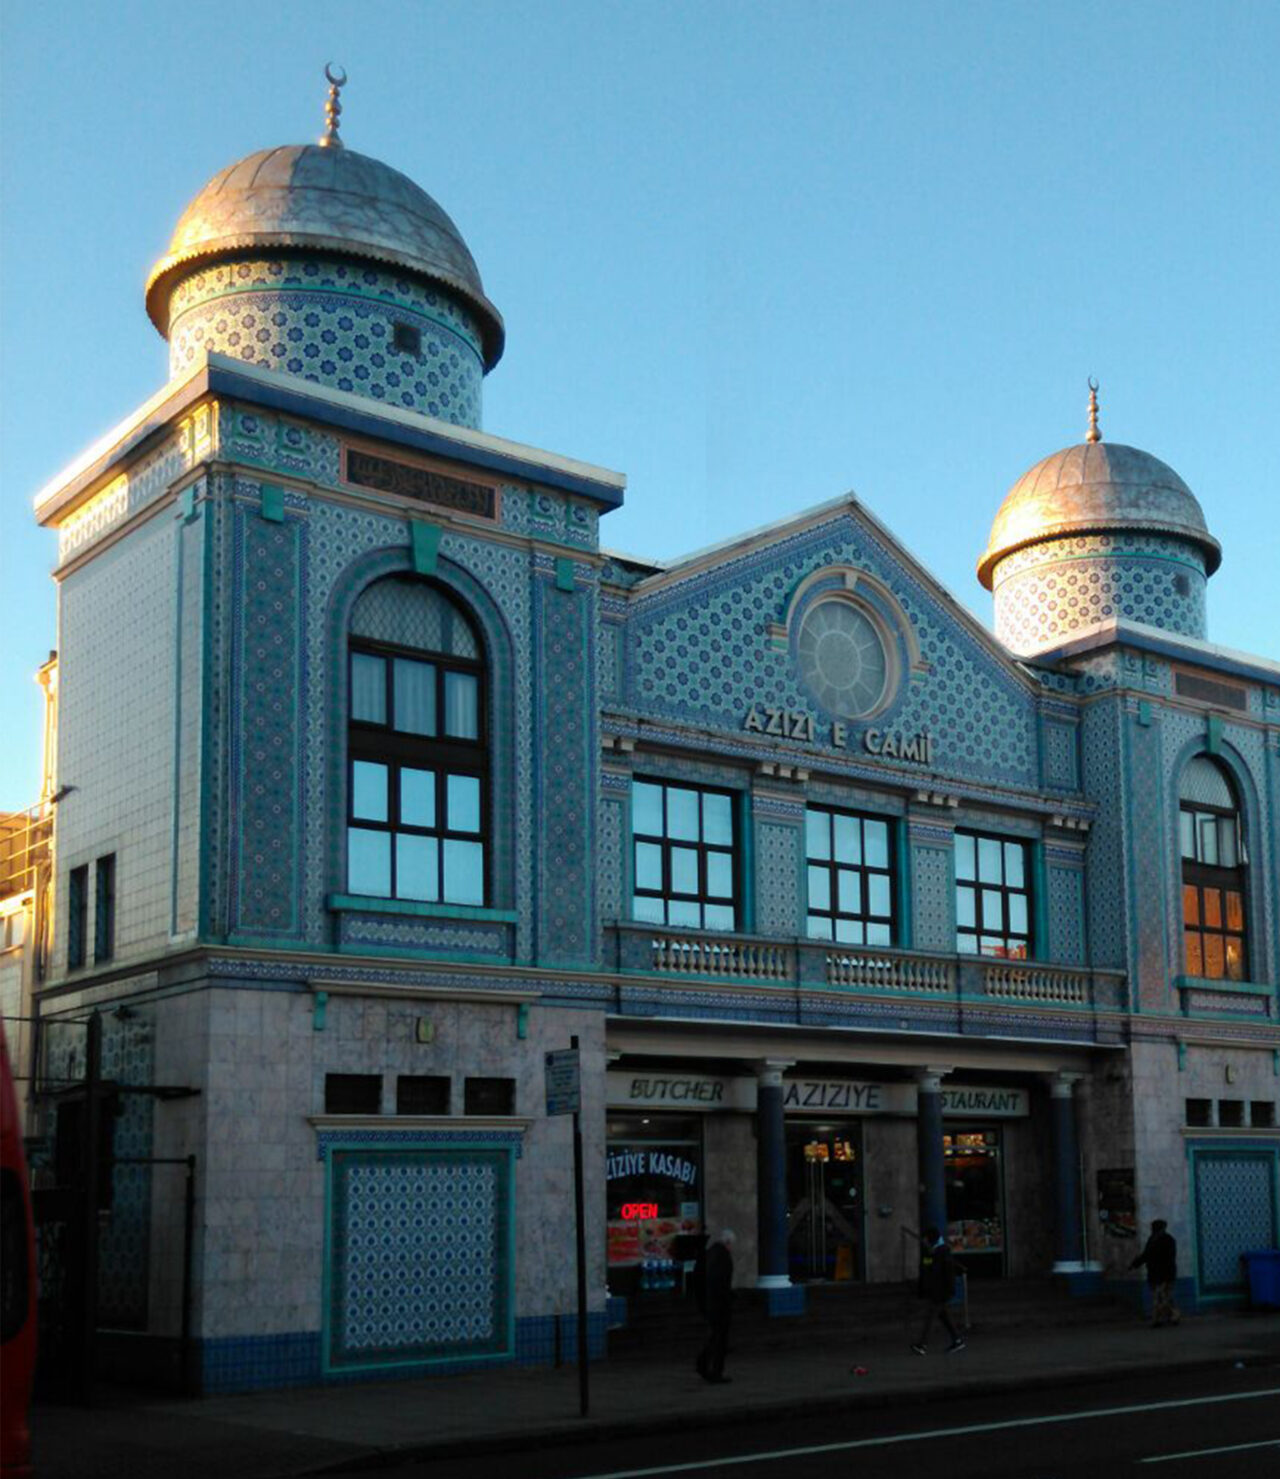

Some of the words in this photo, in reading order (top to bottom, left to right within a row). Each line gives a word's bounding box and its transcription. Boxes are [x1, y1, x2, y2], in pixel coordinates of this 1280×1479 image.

[629, 1078, 724, 1102] BUTCHER
[783, 1082, 882, 1108] AZIZIYE
[942, 1090, 1019, 1111] STAURANT
[606, 1148, 645, 1181] ZİZİYE
[621, 1203, 659, 1220] OPEN
